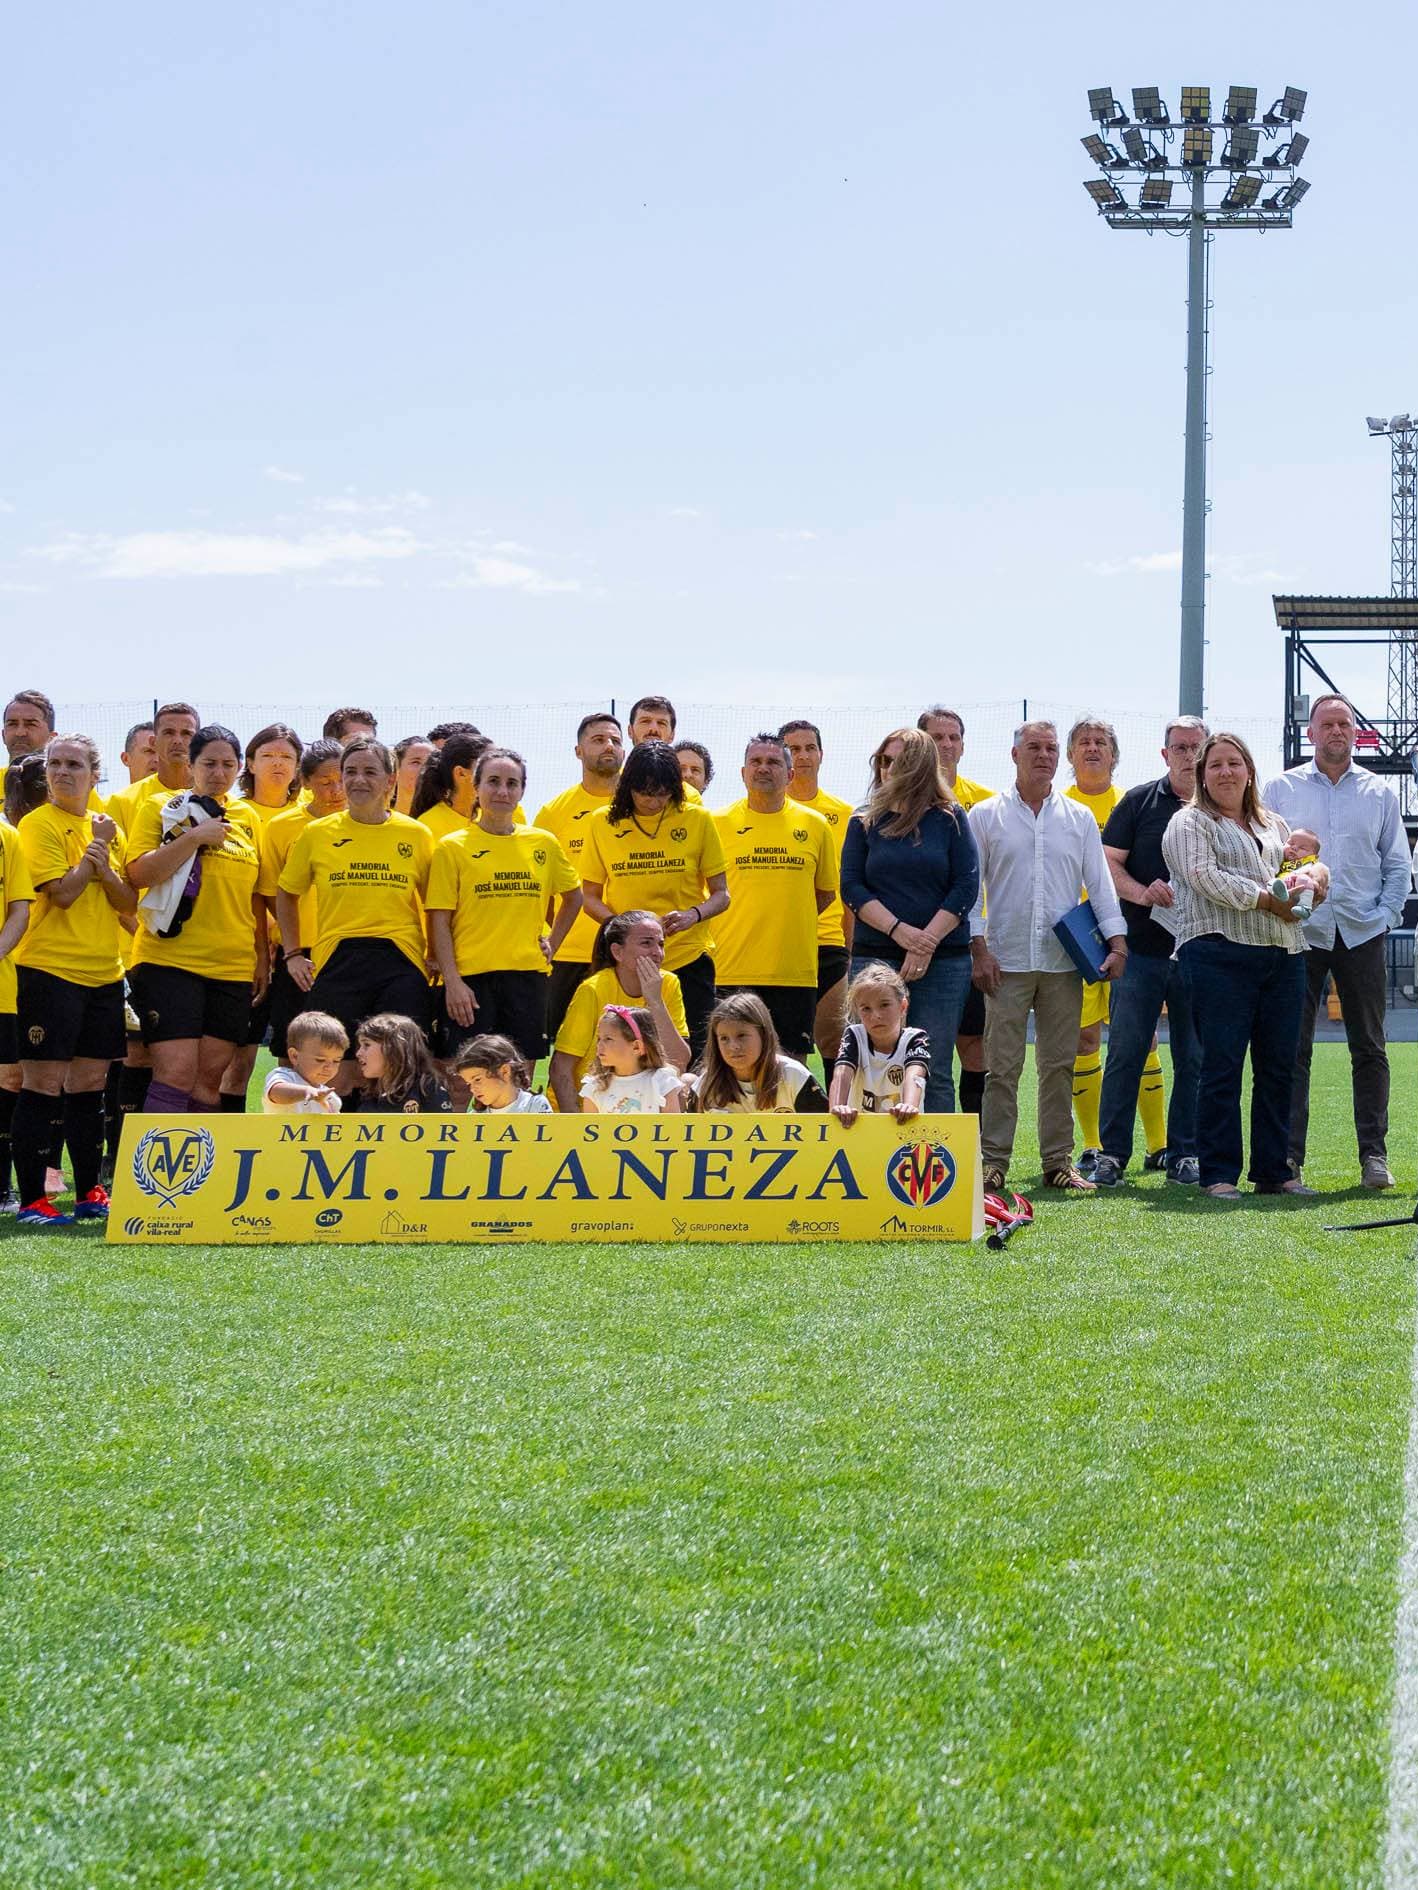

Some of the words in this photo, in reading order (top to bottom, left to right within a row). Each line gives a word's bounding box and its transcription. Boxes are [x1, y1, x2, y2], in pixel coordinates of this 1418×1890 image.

[629, 850, 665, 860] MEMORIAL
[754, 847, 788, 855] MEMORIAL
[611, 861, 625, 872] JOSÉ
[627, 860, 654, 870] MANUEL
[656, 858, 686, 868] LLANEZA
[735, 855, 750, 865] JOSÉ
[752, 856, 778, 865] MANUEL
[350, 862, 390, 872] MEMORIAL
[329, 870, 345, 881] JOSÉ
[347, 871, 379, 881] MANUEL
[381, 872, 408, 883] LLANEZA
[494, 871, 531, 880] MEMORIAL
[474, 881, 491, 893] JOSÉ
[493, 882, 520, 891] MANUEL
[279, 1124, 553, 1142] MEMORIAL
[583, 1124, 829, 1142] SOLIDARI
[419, 1148, 868, 1200] LLANEZA
[147, 1221, 170, 1229] caixa
[172, 1221, 194, 1229] rural
[402, 1223, 428, 1233] D&R
[802, 1221, 840, 1232] ROOTS
[147, 1228, 181, 1236] vila-real
